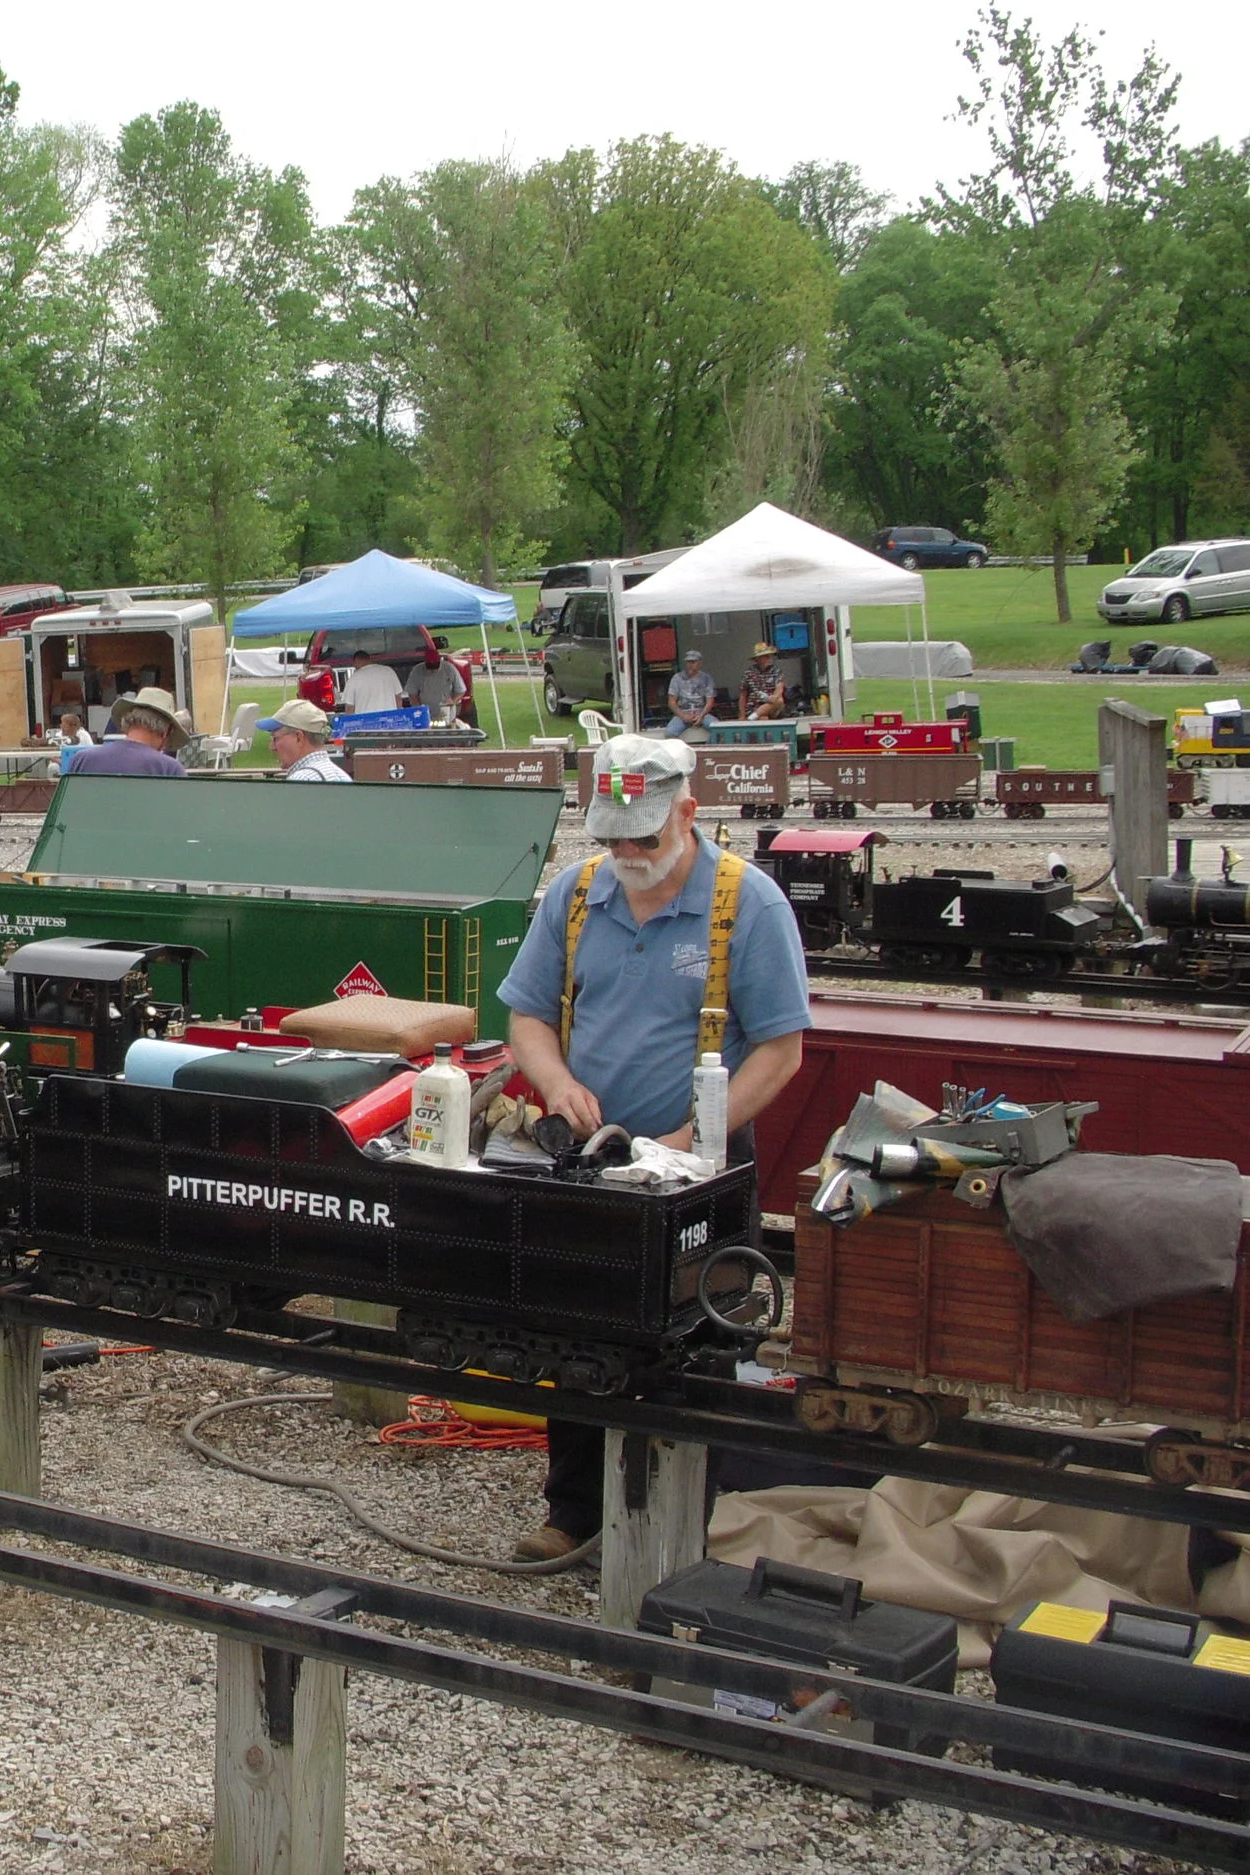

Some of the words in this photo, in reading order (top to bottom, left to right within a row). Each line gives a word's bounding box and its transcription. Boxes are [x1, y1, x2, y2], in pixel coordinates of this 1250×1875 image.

[730, 764, 769, 780] Chief
[727, 781, 774, 793] California
[1004, 782, 1093, 792] SOUTHE
[940, 895, 965, 927] 4
[15, 915, 67, 928] EXPRESS
[342, 977, 383, 993] RAILWAY
[415, 1107, 444, 1122] GTX
[167, 1174, 342, 1220] PITTERPUFFER
[349, 1199, 396, 1228] R.R.
[679, 1220, 708, 1252] 1198
